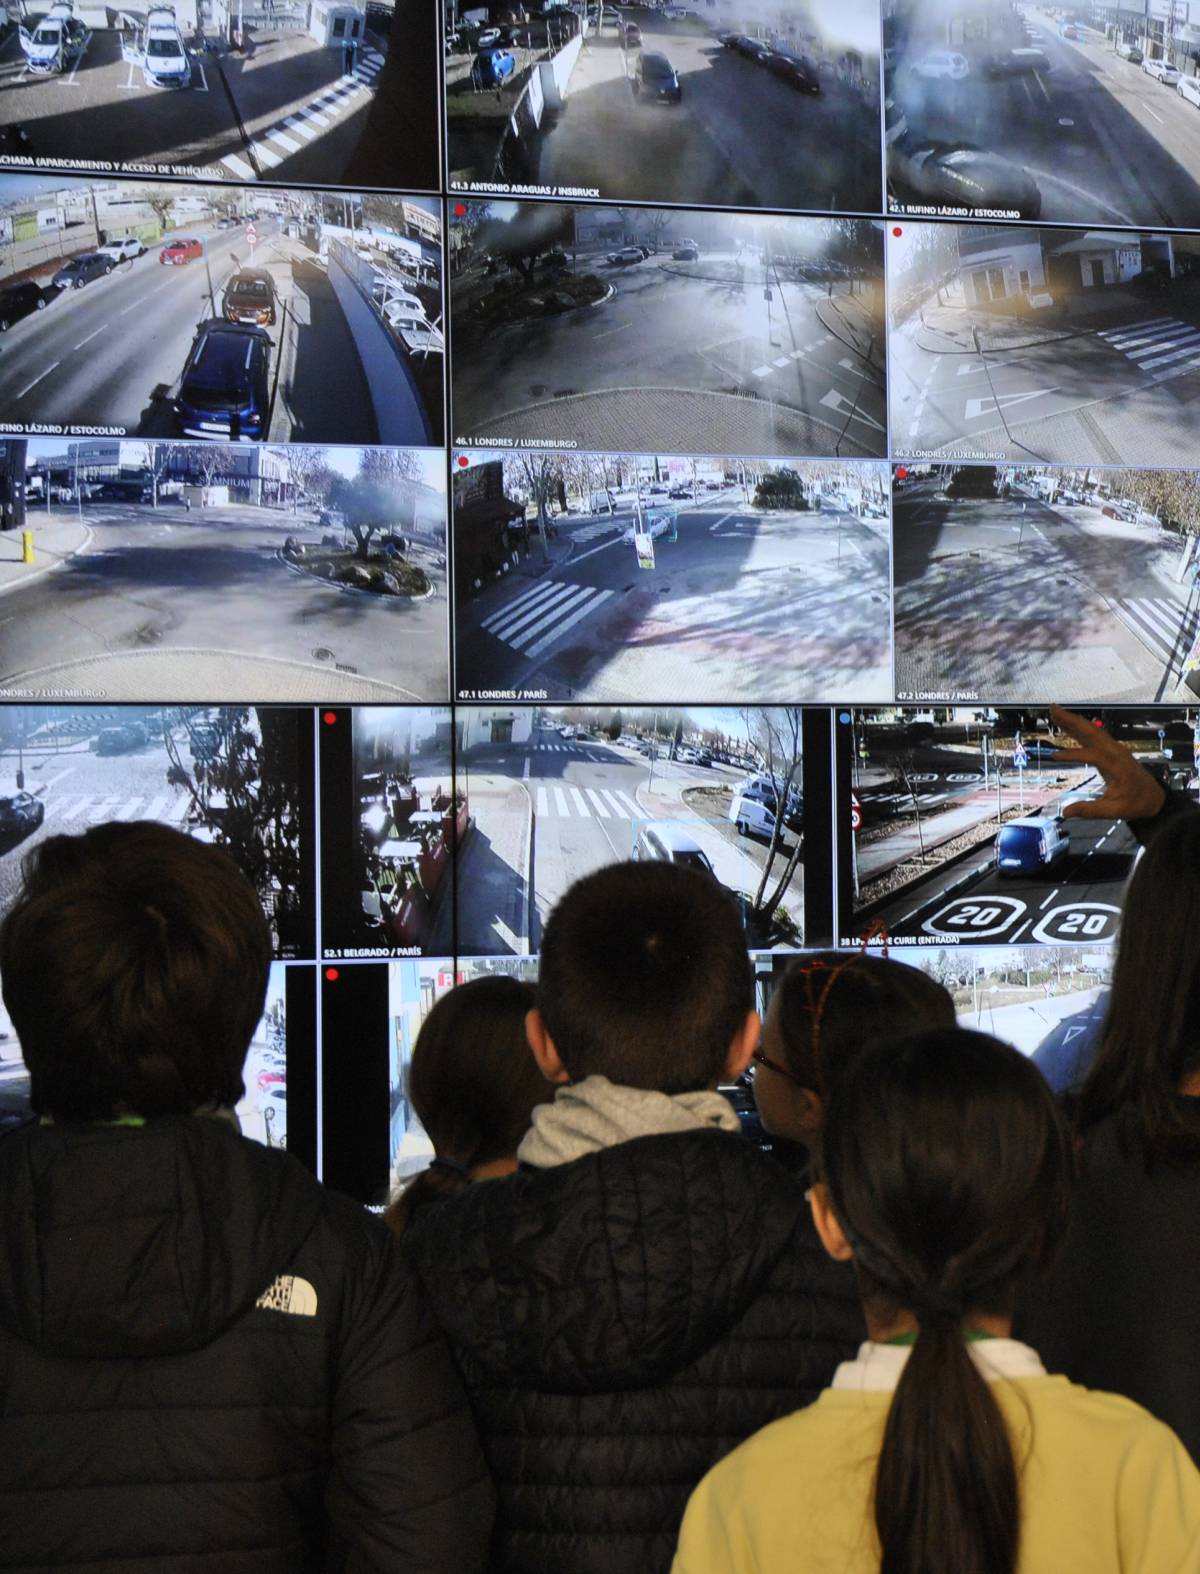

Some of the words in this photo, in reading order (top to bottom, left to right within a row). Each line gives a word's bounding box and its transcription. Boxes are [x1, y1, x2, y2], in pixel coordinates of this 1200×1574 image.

[0, 155, 34, 167] CHADA
[36, 156, 112, 171] (APARCAMIENTO
[113, 161, 120, 171] Y
[122, 162, 156, 174] ACCESO
[158, 164, 171, 175] DE
[451, 181, 469, 191] 41.3
[470, 182, 510, 194] ANTONIO
[511, 184, 551, 195] ARAGUAS
[558, 186, 600, 198] INSBRUCK
[889, 205, 905, 214] 42.1
[907, 205, 936, 215] RUFINO
[937, 205, 968, 217] LÁZARO
[975, 208, 1020, 219] ESTOCOLMO
[0, 423, 24, 433] FINO
[25, 422, 63, 434] LÁZARO
[70, 425, 126, 436] ESTOCOLMO
[455, 437, 473, 446] 46.1
[474, 437, 513, 447] LONDRES
[520, 439, 578, 449] LUXEMBURGO
[912, 450, 947, 459] LONDRES
[953, 450, 1006, 460] LUXEMBURGO
[41, 688, 107, 698] LUXEMBURGO
[458, 690, 476, 699] 47.1
[477, 690, 517, 699] LONDRES
[523, 688, 548, 700] PARÍS
[897, 691, 914, 700] 47.2
[914, 691, 950, 700] LONDRES
[957, 690, 979, 700] PARÍS
[946, 905, 1002, 927] 20
[1057, 913, 1108, 935] 20
[893, 935, 917, 945] CURIE
[917, 935, 960, 945] (ENTRADA)
[324, 948, 342, 958] 52.1
[343, 947, 390, 958] BELGRADO
[397, 945, 422, 956] PARÍS
